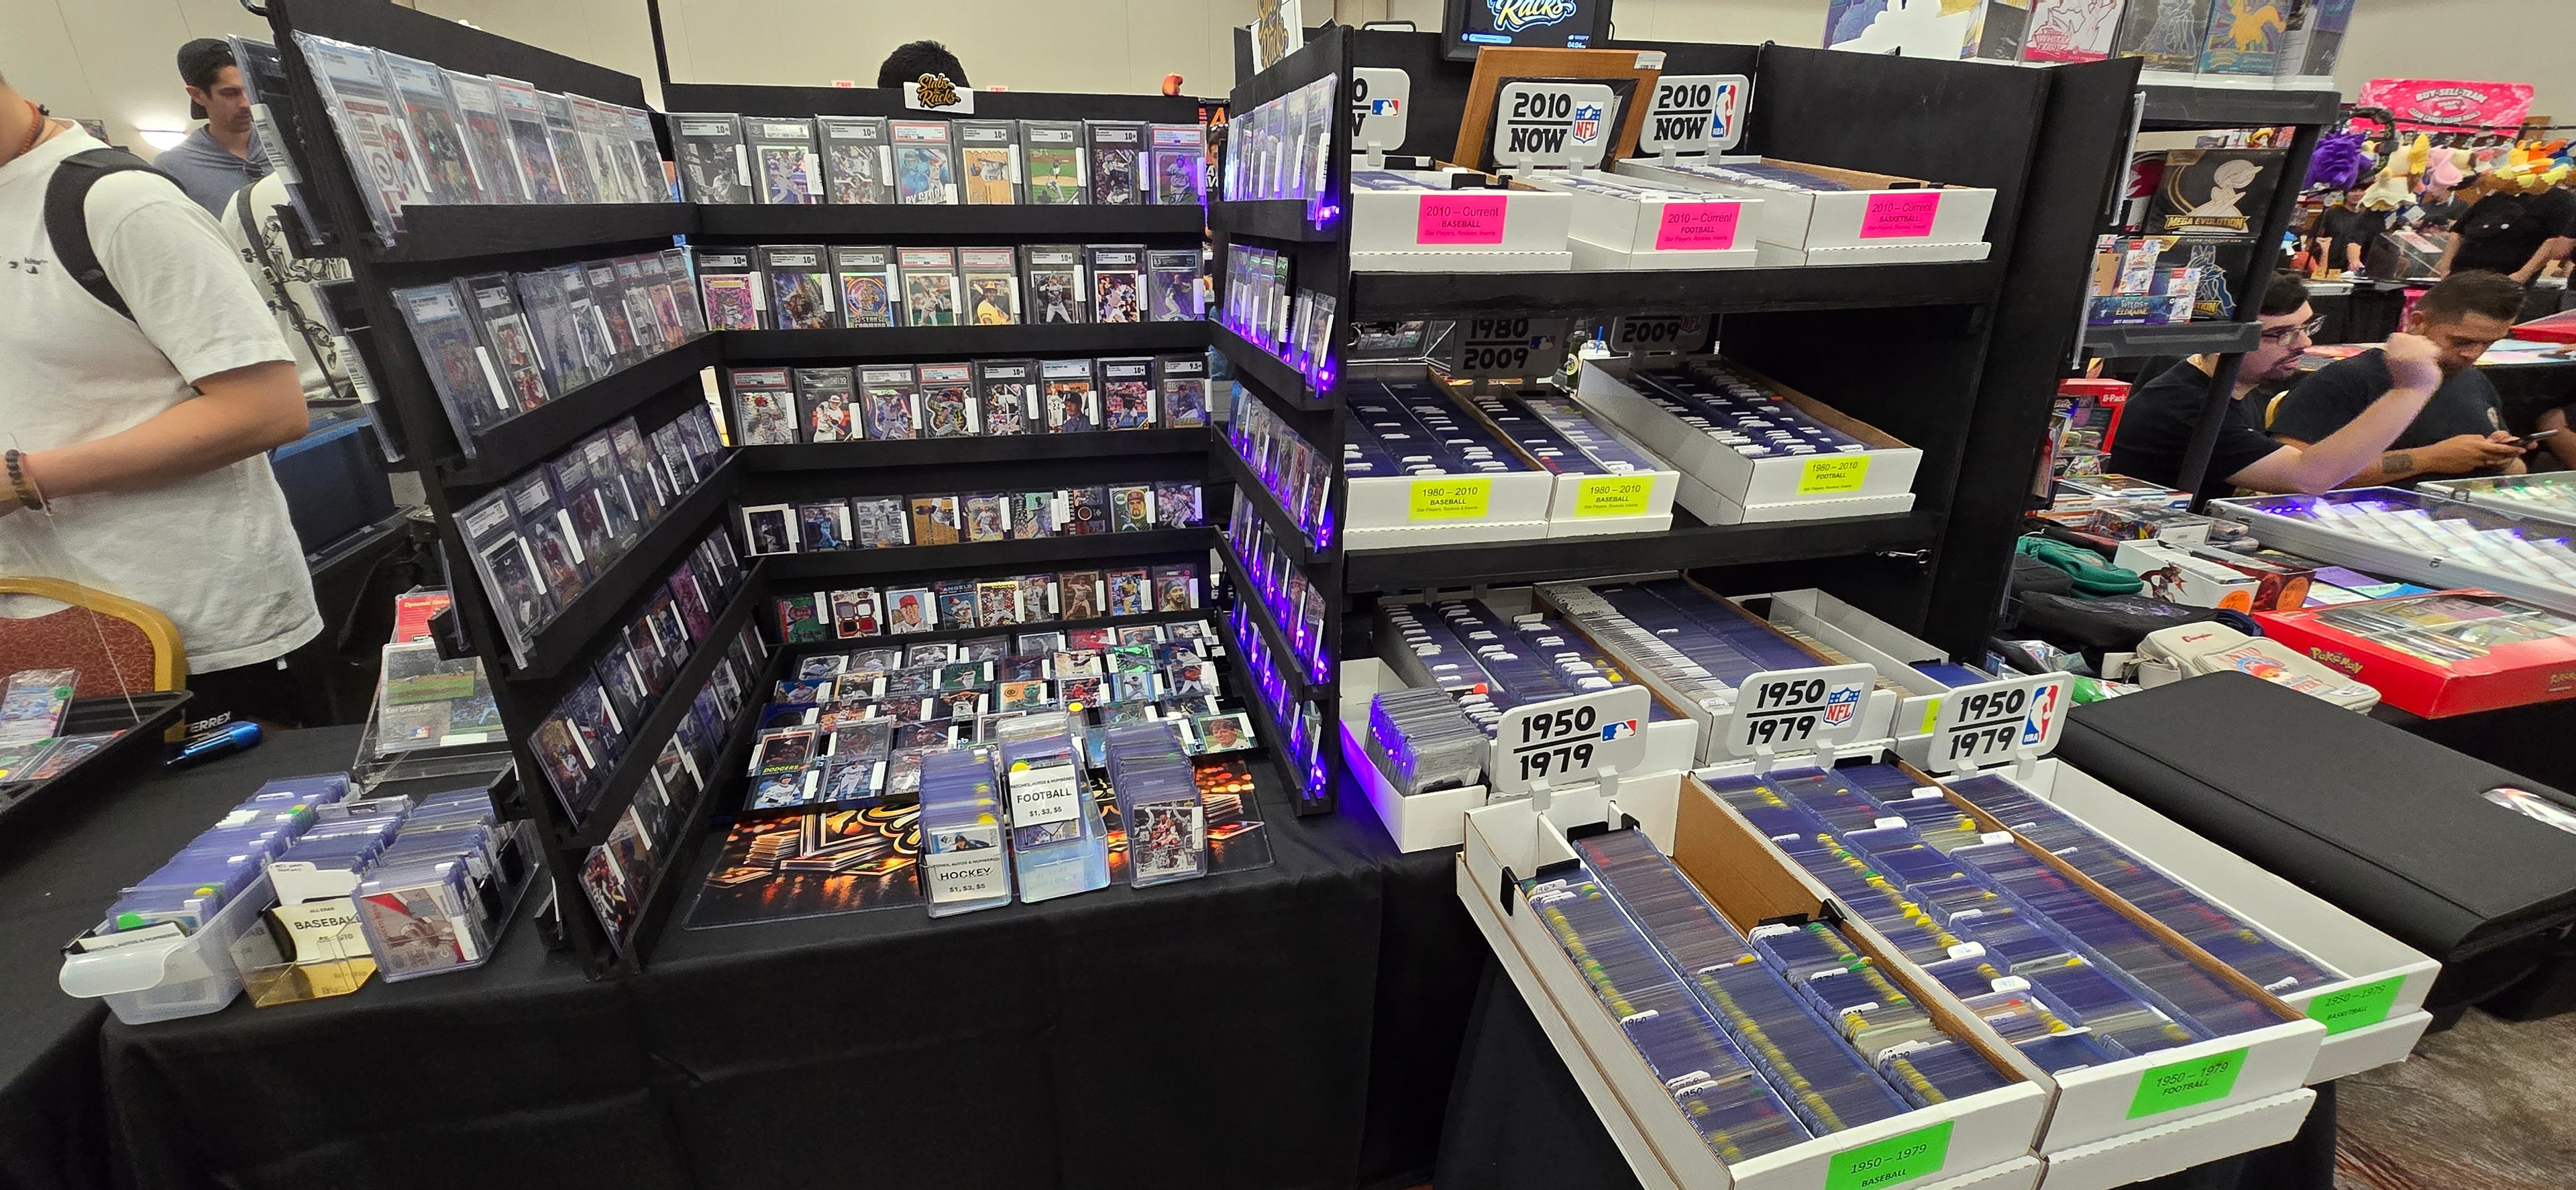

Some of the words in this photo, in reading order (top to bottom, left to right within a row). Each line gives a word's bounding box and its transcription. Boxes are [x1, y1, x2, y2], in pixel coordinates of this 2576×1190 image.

[918, 74, 951, 92] Slabs
[918, 91, 960, 107] Racks
[1513, 93, 1571, 118] 2010
[1658, 85, 1711, 109] 2010
[1575, 121, 1597, 139] NFL
[1654, 117, 1707, 141] NOW
[1509, 127, 1568, 153] NOW
[1426, 206, 1451, 216] 2010
[1463, 206, 1499, 217] Current
[1872, 203, 1894, 213] 2010
[1902, 203, 1933, 212] Current
[1668, 213, 1690, 223] 2010
[1701, 213, 1732, 223] Current
[2167, 217, 2193, 227] MEGA
[2195, 217, 2244, 229] EVOLUTION
[1470, 317, 1529, 339] 1980
[1622, 323, 1680, 343] 2009
[1463, 348, 1529, 370] 2009
[2102, 394, 2126, 402] 8-Pack
[1813, 464, 1830, 472] 1980
[1839, 462, 1858, 470] 2010
[1422, 488, 1444, 497] 1980
[1455, 487, 1478, 496] 2010
[1591, 486, 1610, 494] 1980
[1620, 485, 1641, 493] 2010
[1757, 679, 1825, 709] 1950
[1826, 703, 1851, 721] NFL
[1958, 689, 2025, 722] 1950
[189, 711, 231, 733] ERREX
[1521, 706, 1596, 743] 1950
[1746, 716, 1816, 745] 1979
[1949, 726, 2016, 760] 1979
[2024, 733, 2038, 743] NBA
[763, 764, 799, 773] DODGERS
[1520, 743, 1594, 781] 1979
[1017, 788, 1072, 804] FOOTBALL
[941, 867, 991, 881] HOCKEY
[2157, 1072, 2186, 1087] 1950
[2201, 1062, 2229, 1077] 1979
[2162, 1079, 2209, 1096] FOOTBALL
[1851, 1157, 1882, 1175] 1950
[1896, 1144, 1927, 1161] 1979
[1862, 1169, 1907, 1187] BASEBALL
